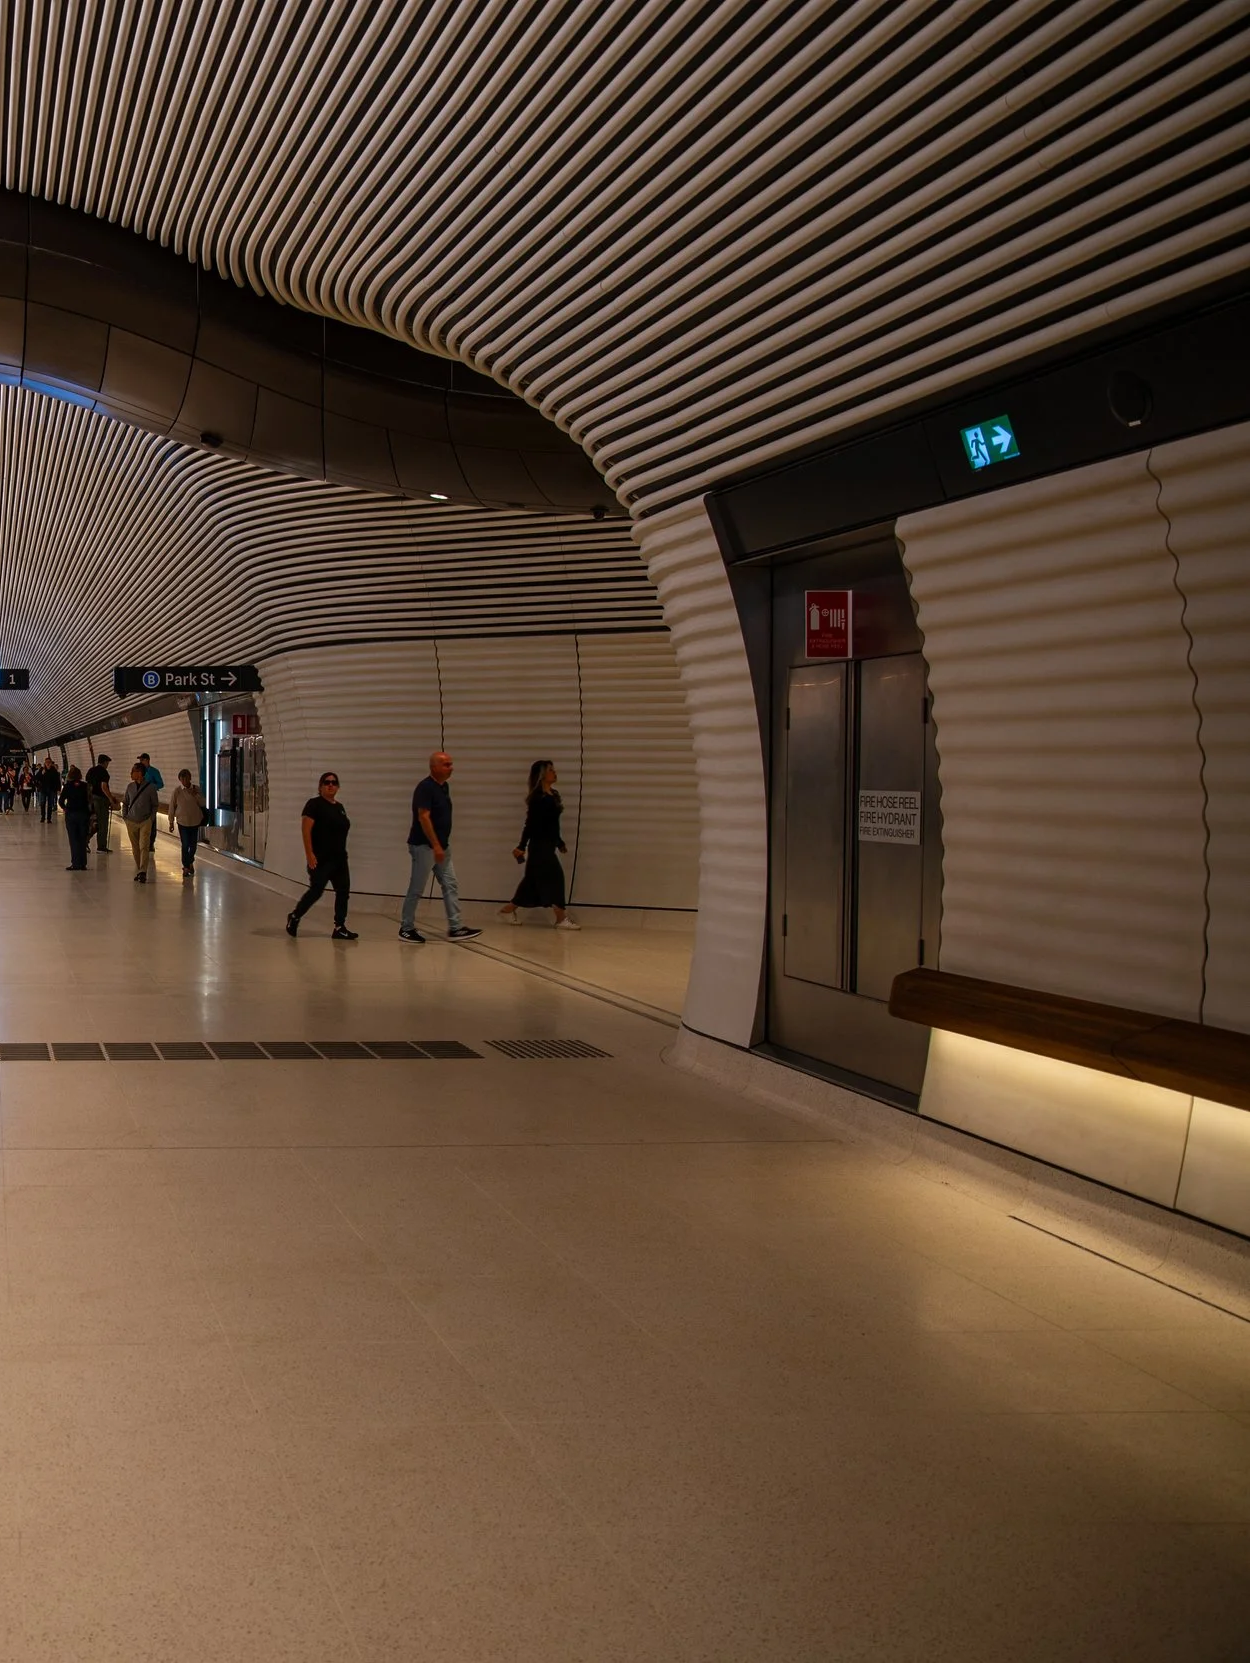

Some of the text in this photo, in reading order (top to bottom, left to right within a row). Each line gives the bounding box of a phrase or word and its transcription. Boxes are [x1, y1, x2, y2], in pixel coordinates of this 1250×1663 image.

[9, 674, 16, 684] 1
[165, 673, 197, 686] Park
[200, 673, 215, 686] St
[860, 796, 918, 810] FIRE HOSE REEL
[860, 811, 916, 826] FIRE HYDRANT
[860, 826, 914, 838] FIRE EXTINGUISHER
